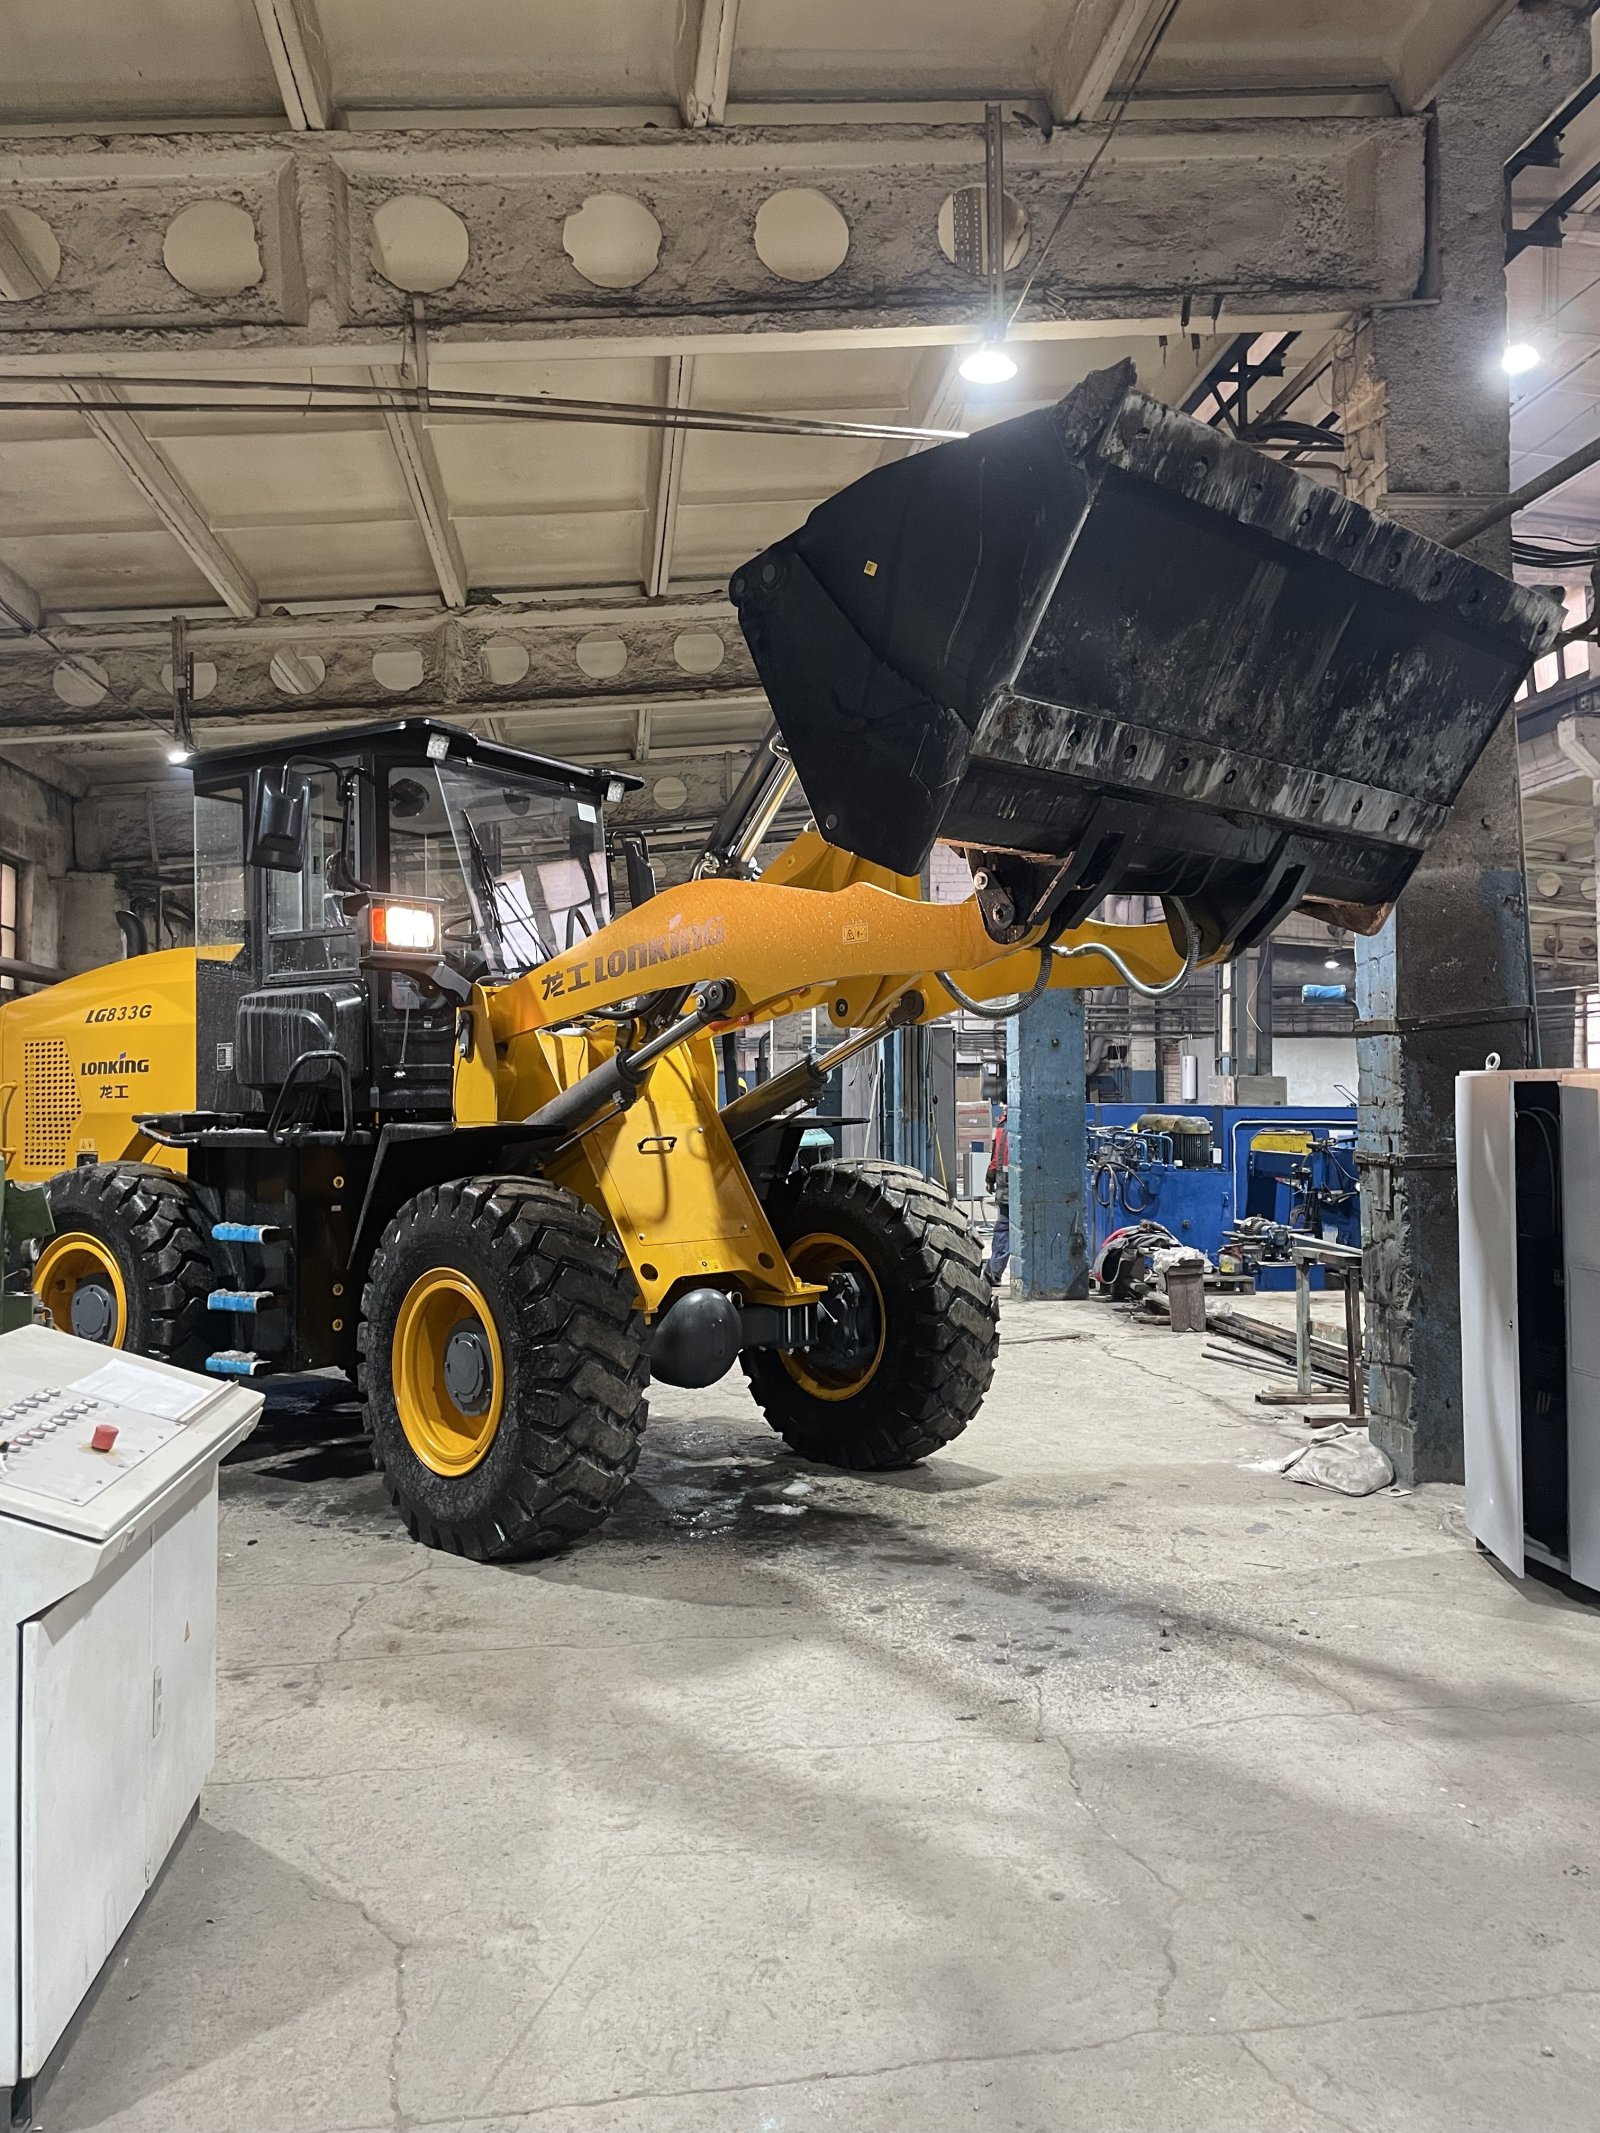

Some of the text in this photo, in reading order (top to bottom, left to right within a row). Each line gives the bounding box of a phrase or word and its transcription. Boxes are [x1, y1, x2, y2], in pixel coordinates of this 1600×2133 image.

[541, 961, 590, 1000] 龙工
[85, 1004, 152, 1024] LG833G
[99, 1085, 129, 1099] 龙工
